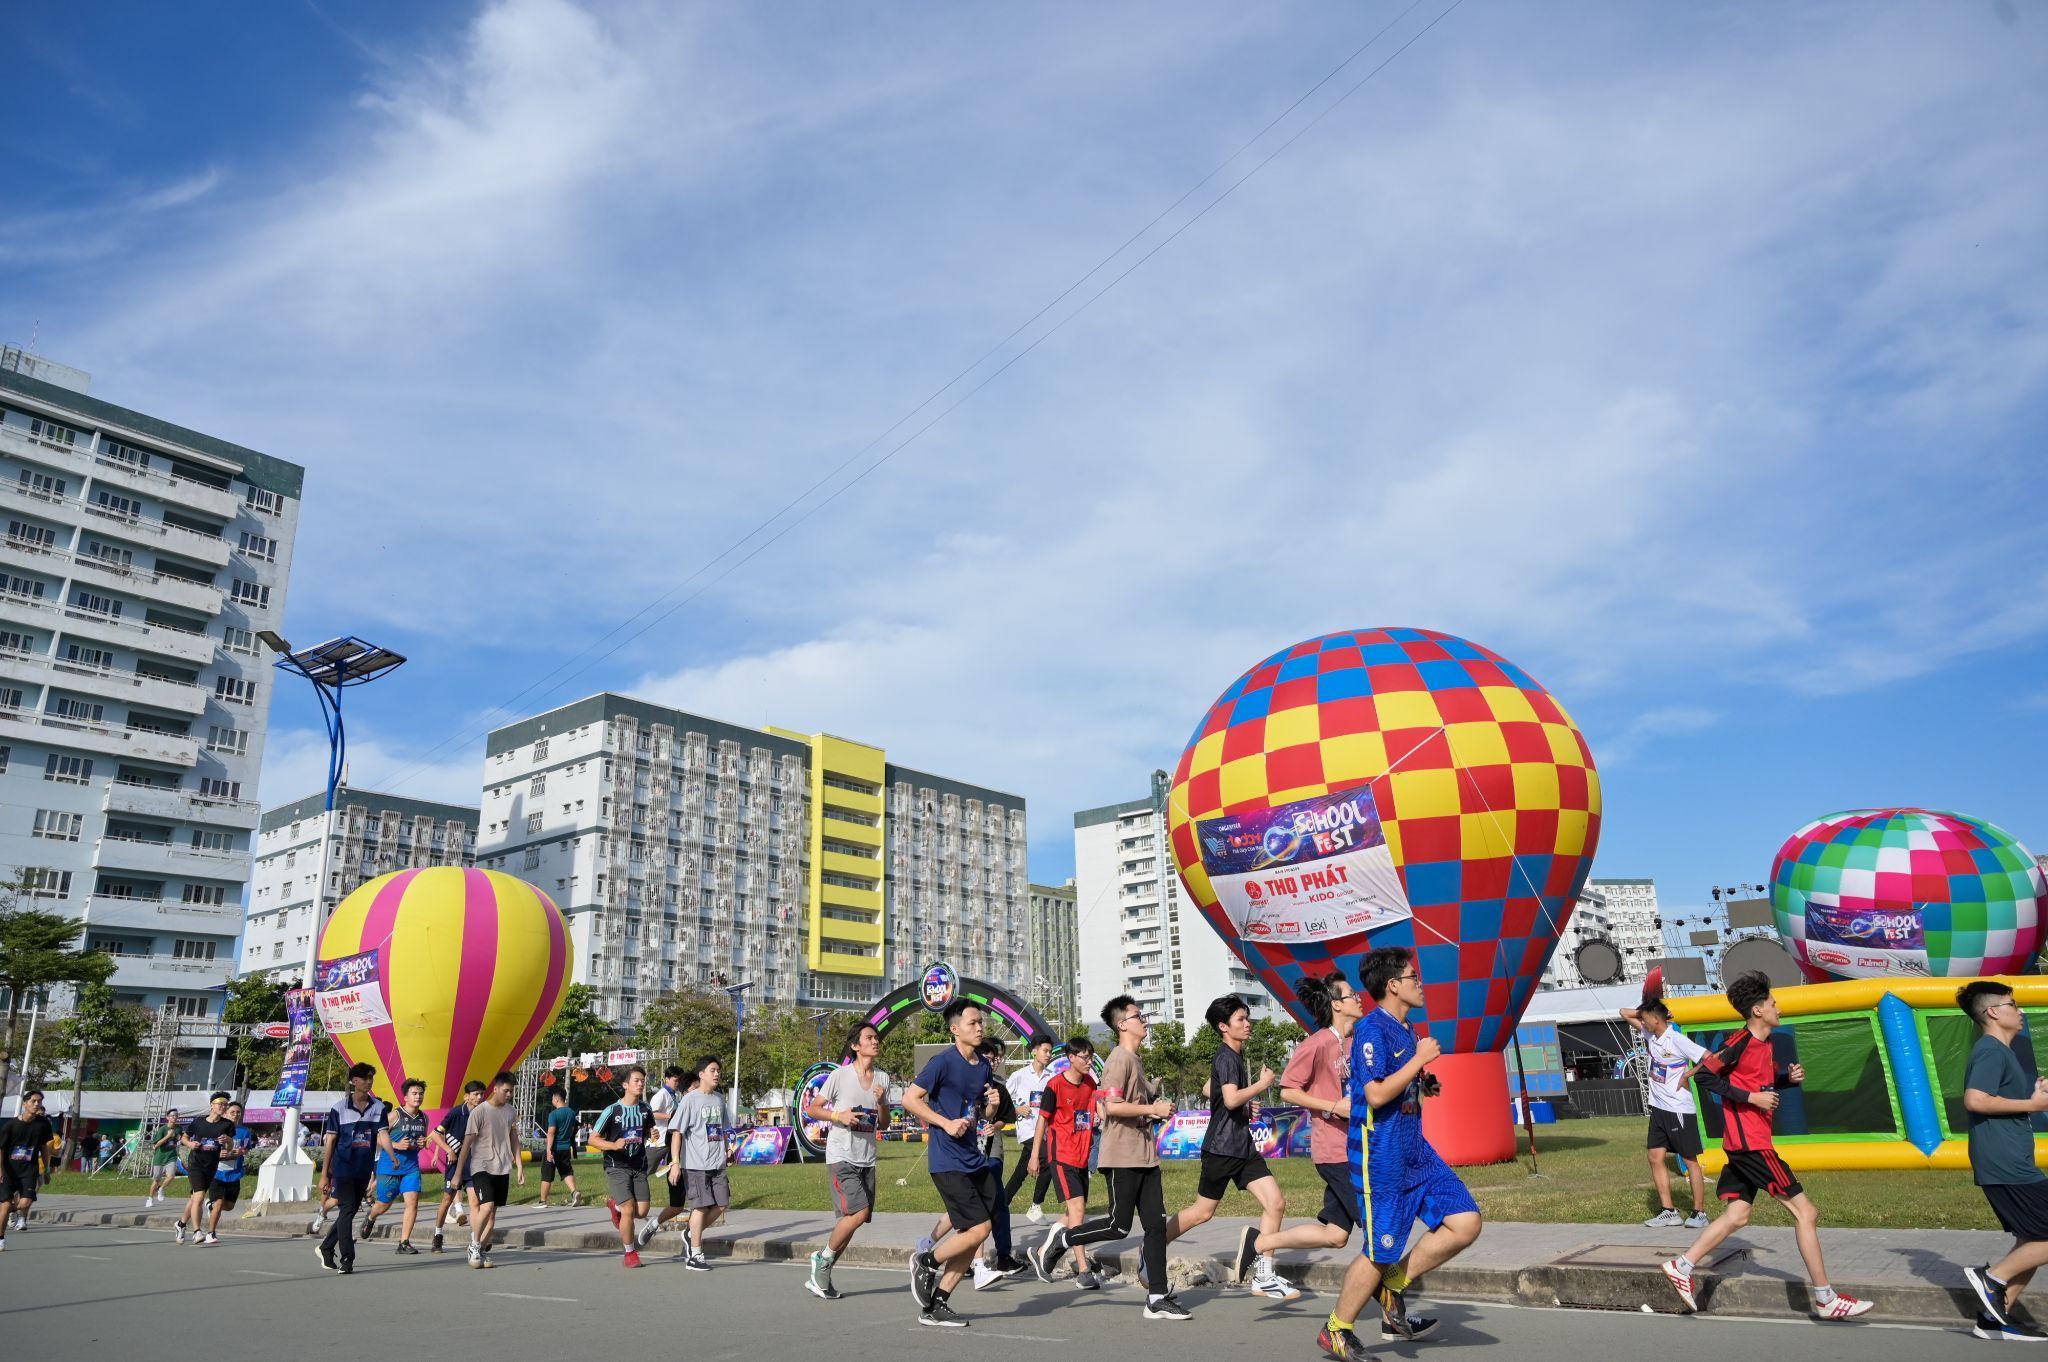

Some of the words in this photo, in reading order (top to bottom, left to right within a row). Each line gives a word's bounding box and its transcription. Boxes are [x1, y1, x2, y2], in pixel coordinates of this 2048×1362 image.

[1294, 800, 1367, 833] SCHOOL
[1264, 877, 1298, 898] THỌ
[1300, 863, 1349, 891] PHÁT
[1309, 891, 1335, 903] KIDO
[1305, 918, 1327, 932] Lexi
[1874, 914, 1919, 928] SCHOOL
